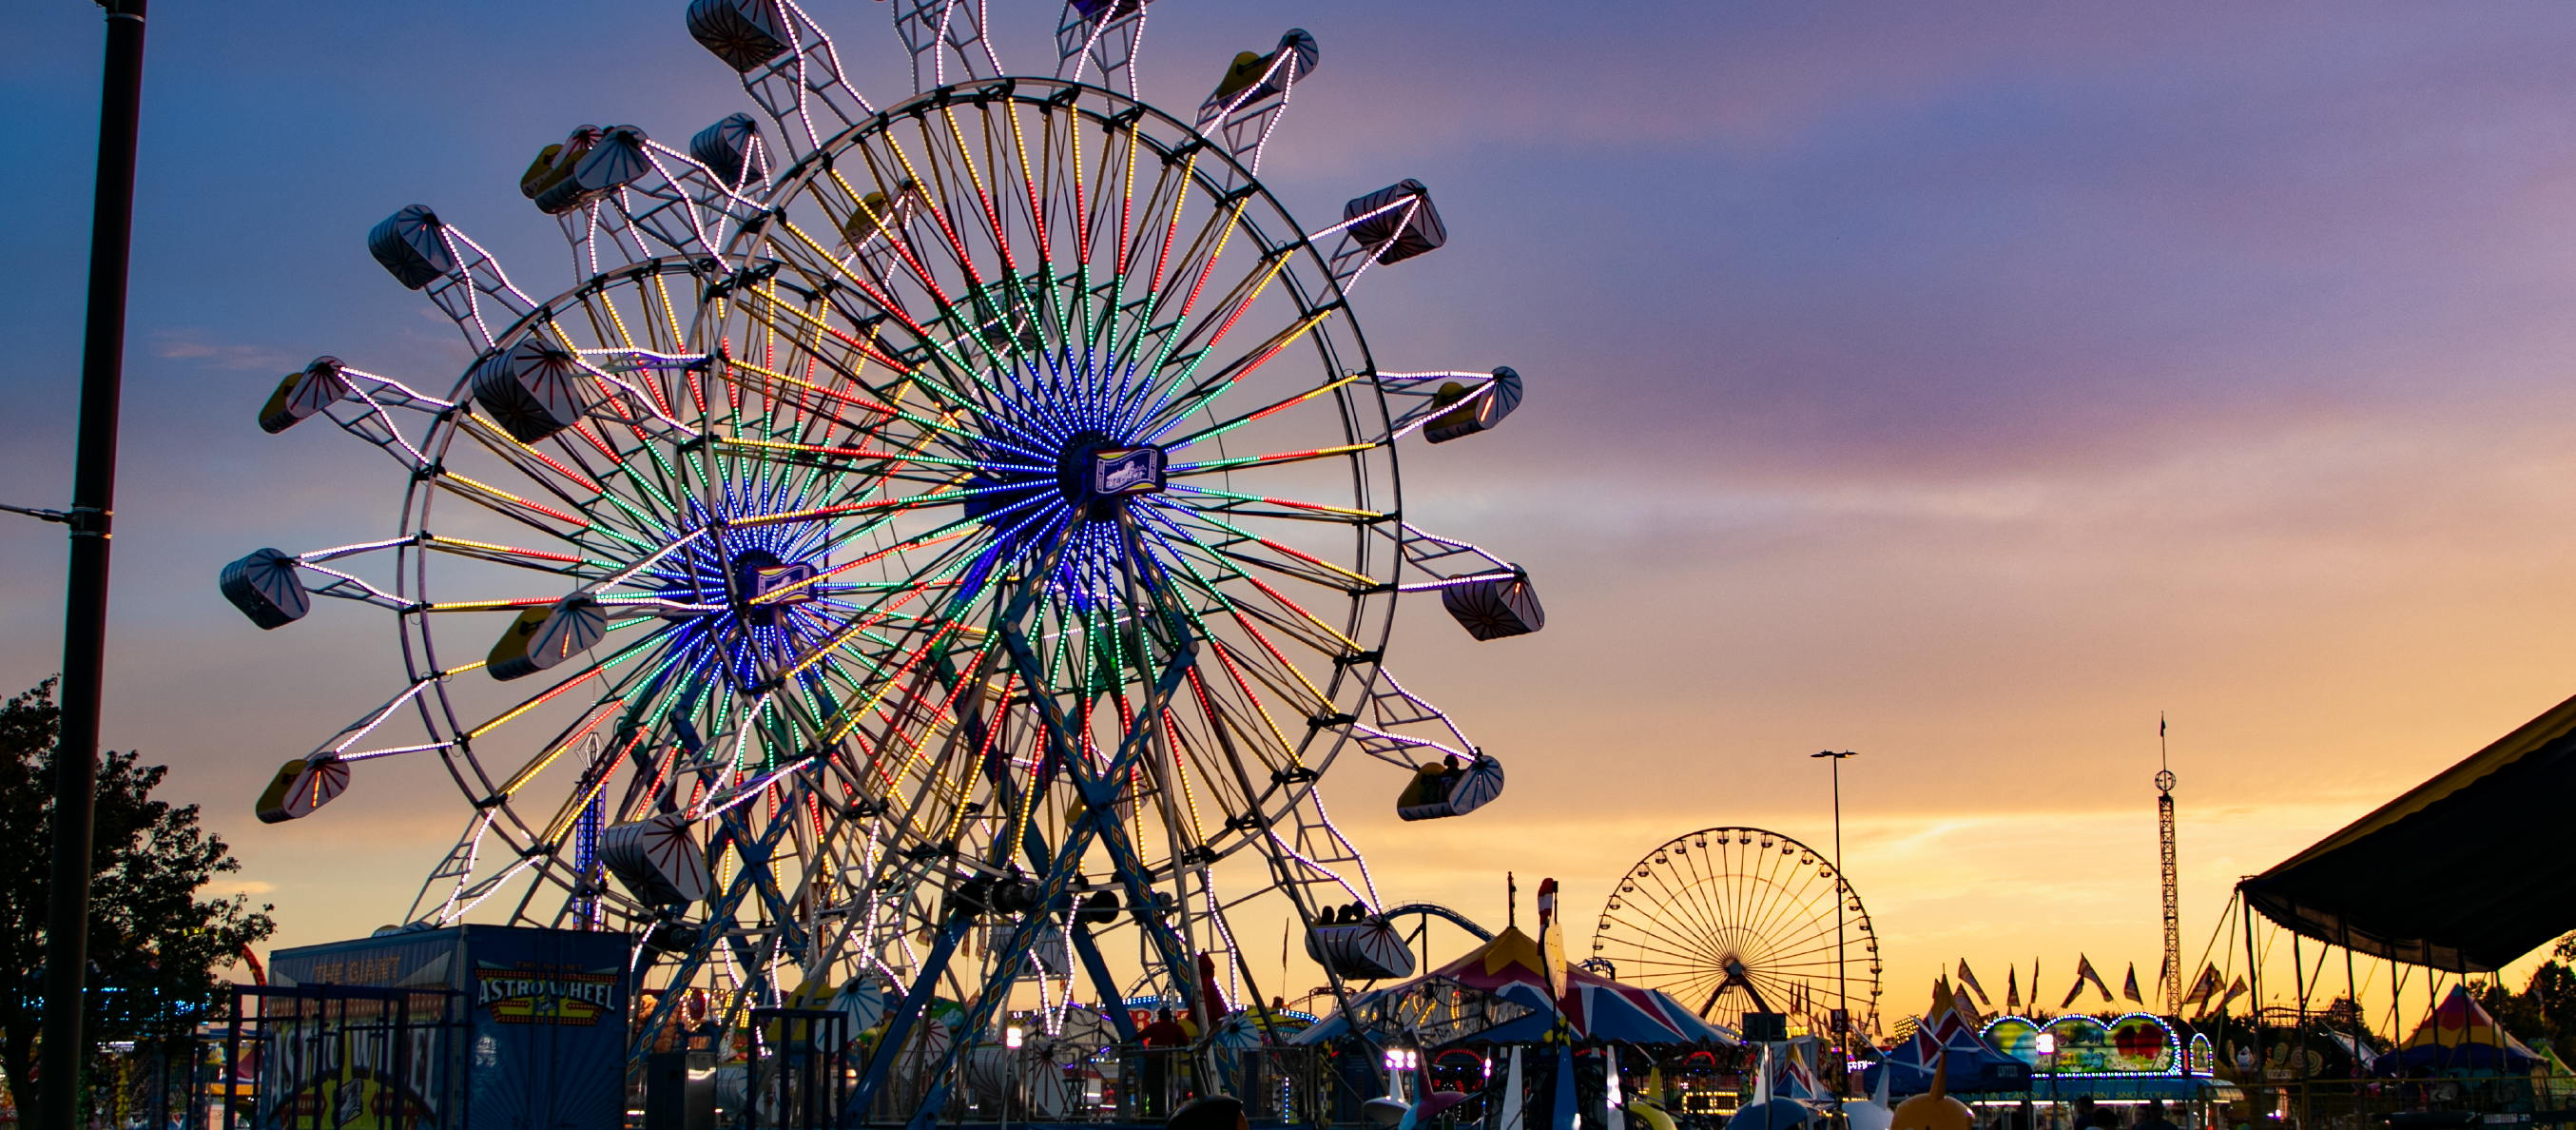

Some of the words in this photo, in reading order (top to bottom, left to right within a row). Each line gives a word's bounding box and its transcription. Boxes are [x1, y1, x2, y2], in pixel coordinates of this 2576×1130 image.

[315, 963, 343, 984] THE
[348, 956, 400, 983] GIANT
[476, 979, 545, 1008] ASTRO
[549, 982, 616, 1012] WHEEL
[1834, 1010, 1843, 1020] N
[1835, 1022, 1843, 1031] 2
[1997, 1064, 2019, 1078] ENTER
